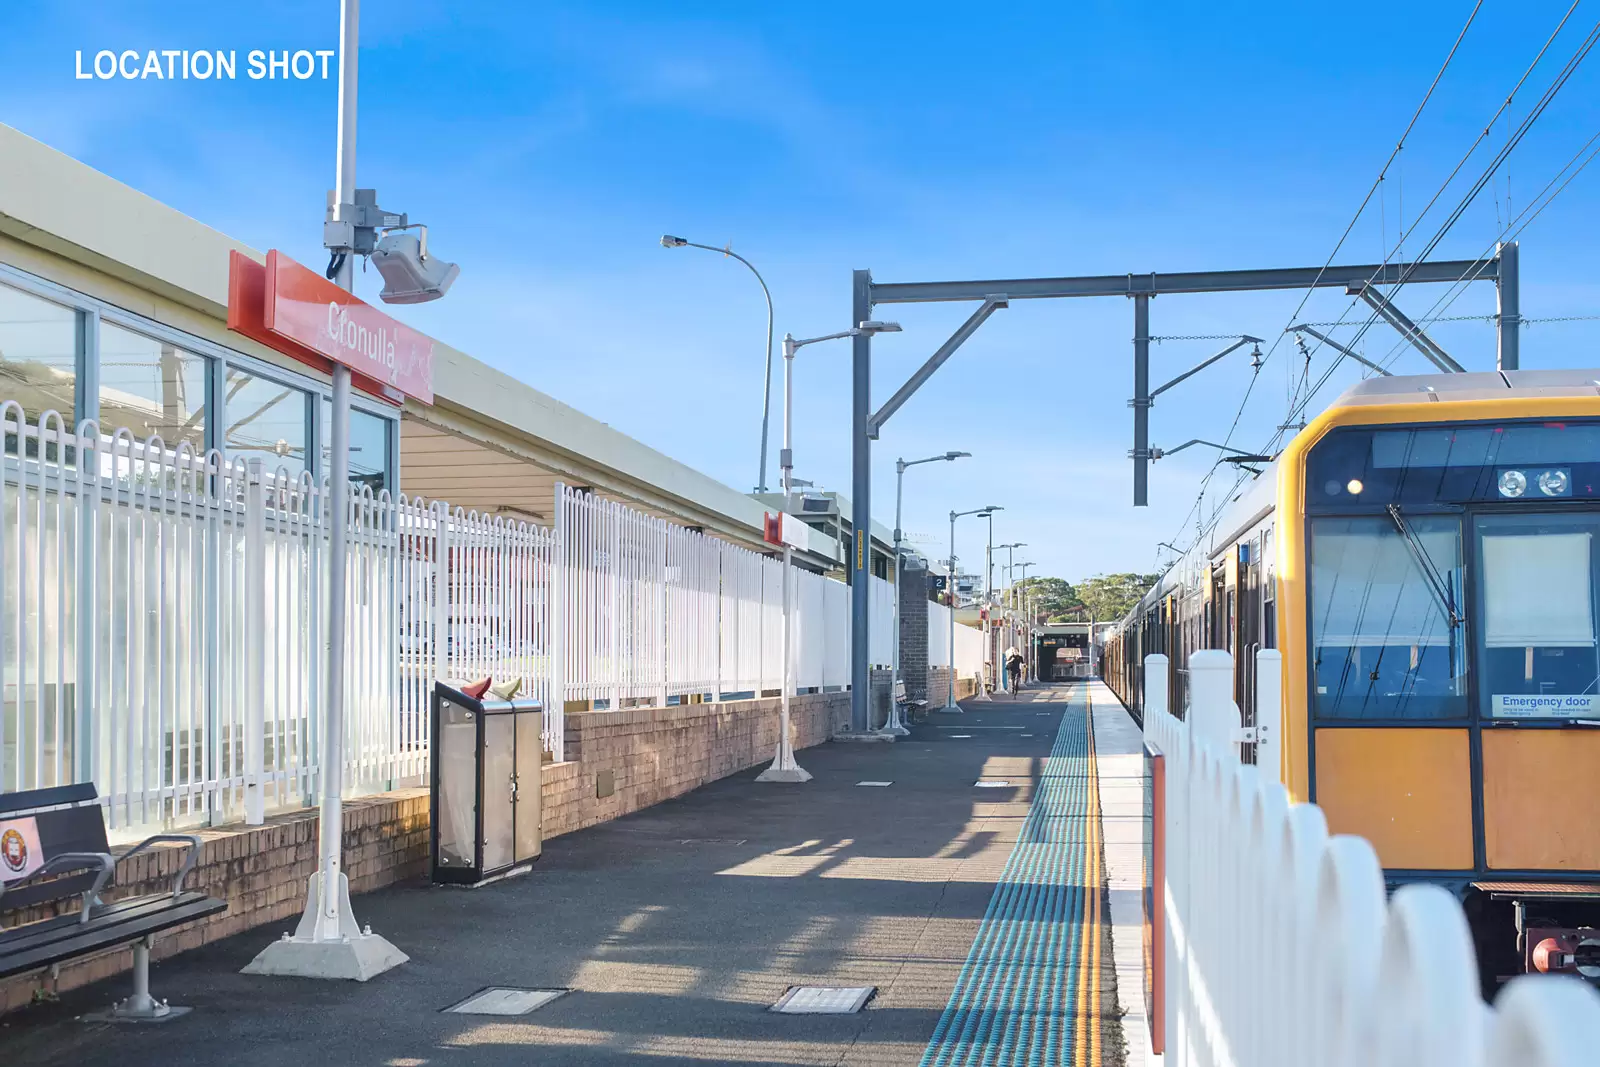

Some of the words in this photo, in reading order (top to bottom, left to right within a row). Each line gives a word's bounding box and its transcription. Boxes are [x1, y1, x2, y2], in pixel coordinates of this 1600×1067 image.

[328, 301, 395, 369] Cronulla
[936, 578, 943, 587] 2
[1502, 696, 1562, 708] Emergency
[1565, 696, 1591, 706] door
